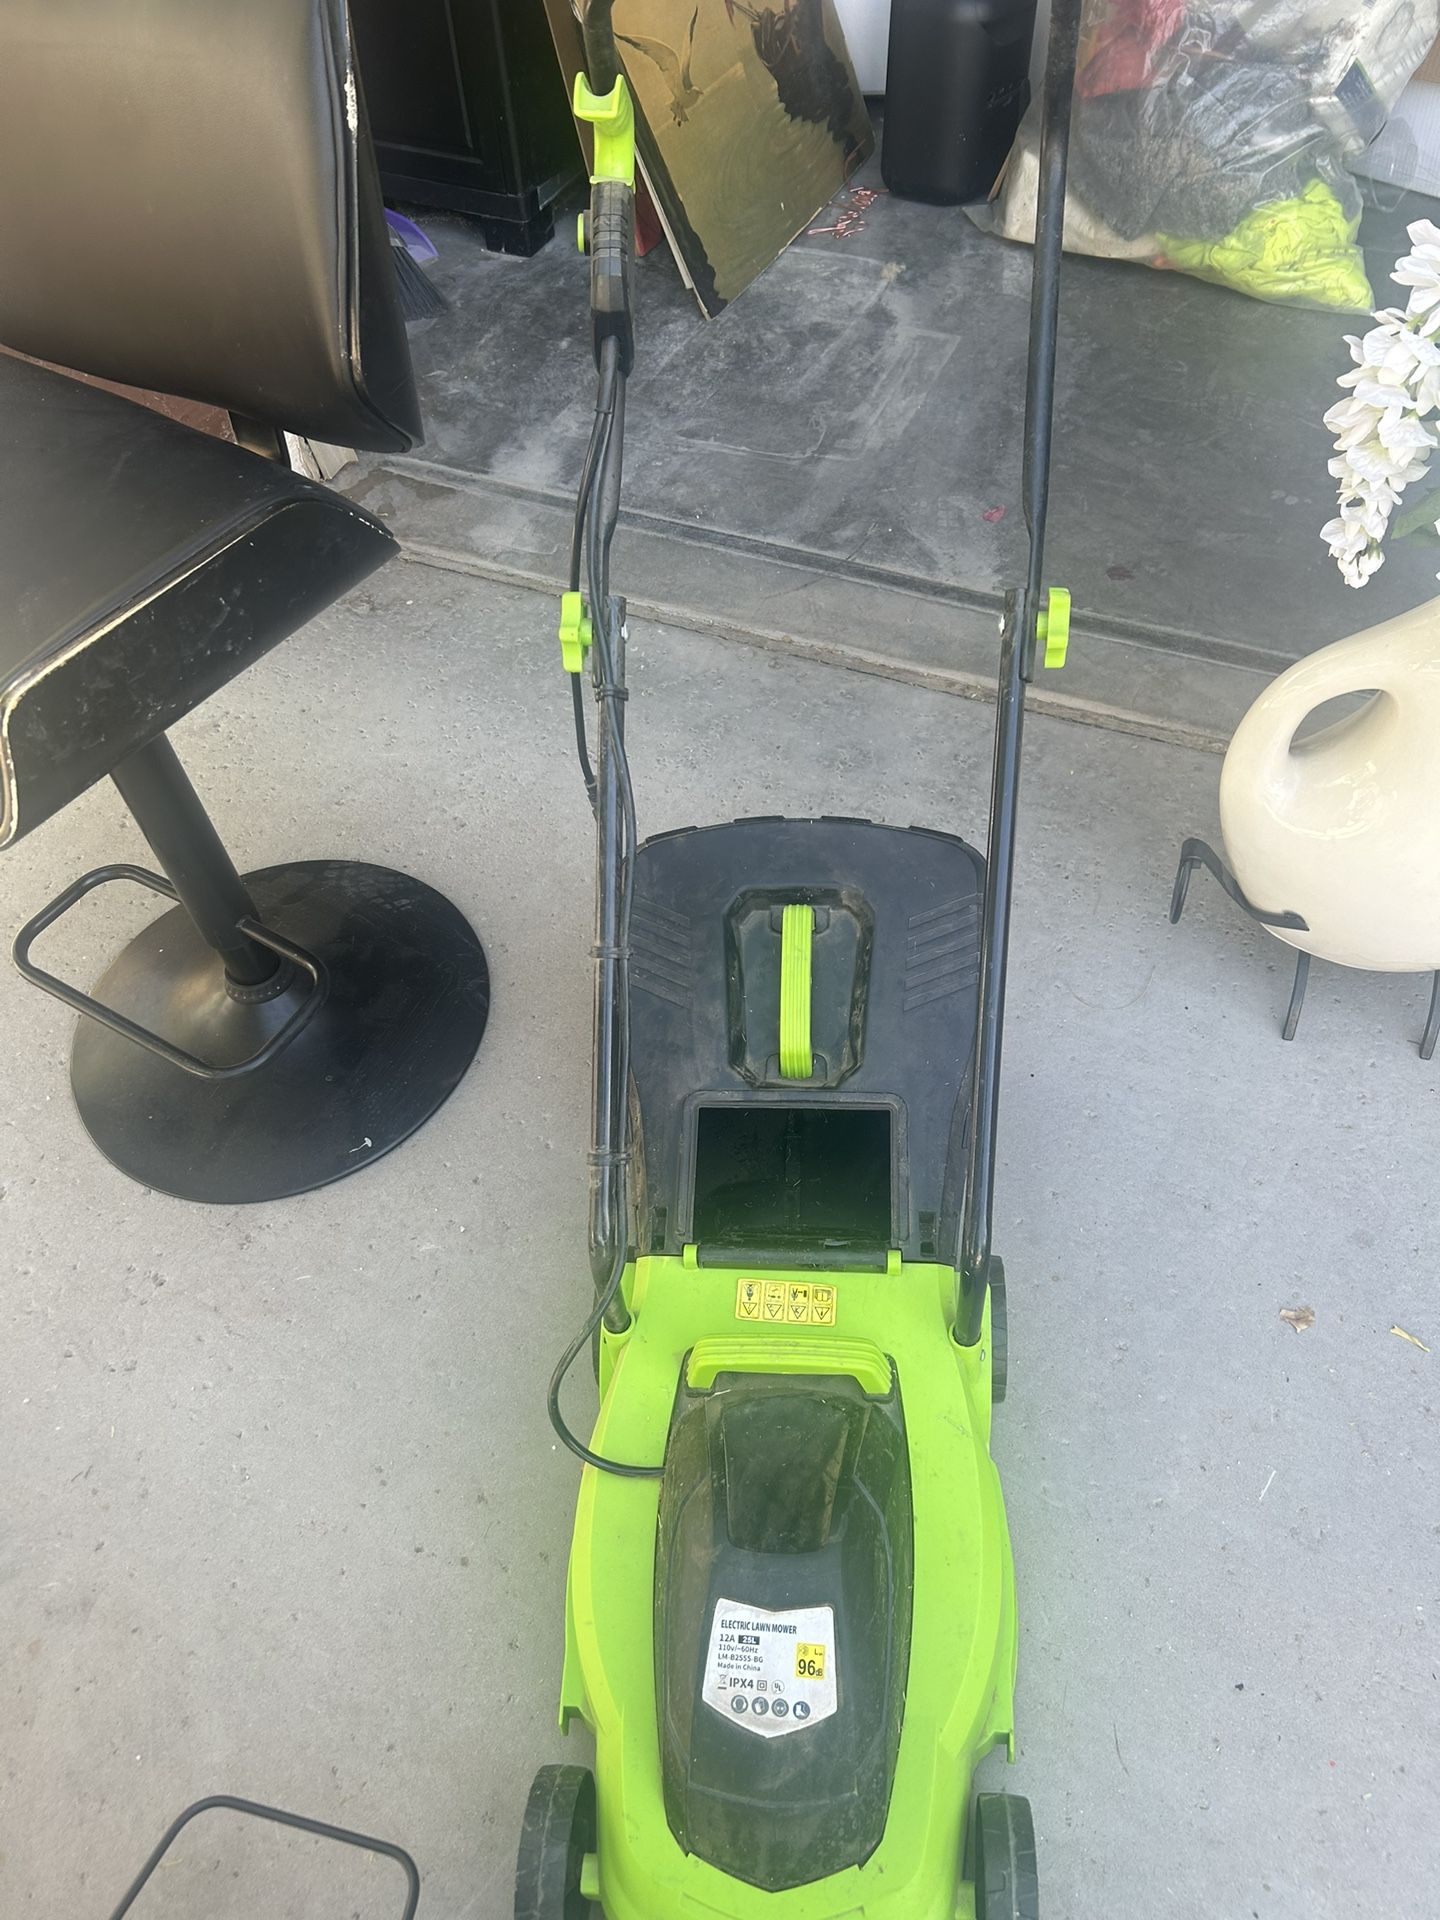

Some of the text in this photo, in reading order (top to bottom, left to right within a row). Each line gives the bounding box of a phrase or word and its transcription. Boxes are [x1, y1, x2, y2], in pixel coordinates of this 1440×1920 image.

[721, 1619, 797, 1634] ELECTRIC LAWN MOWER
[720, 1633, 735, 1642] 12A
[729, 1677, 754, 1689] IPX4
